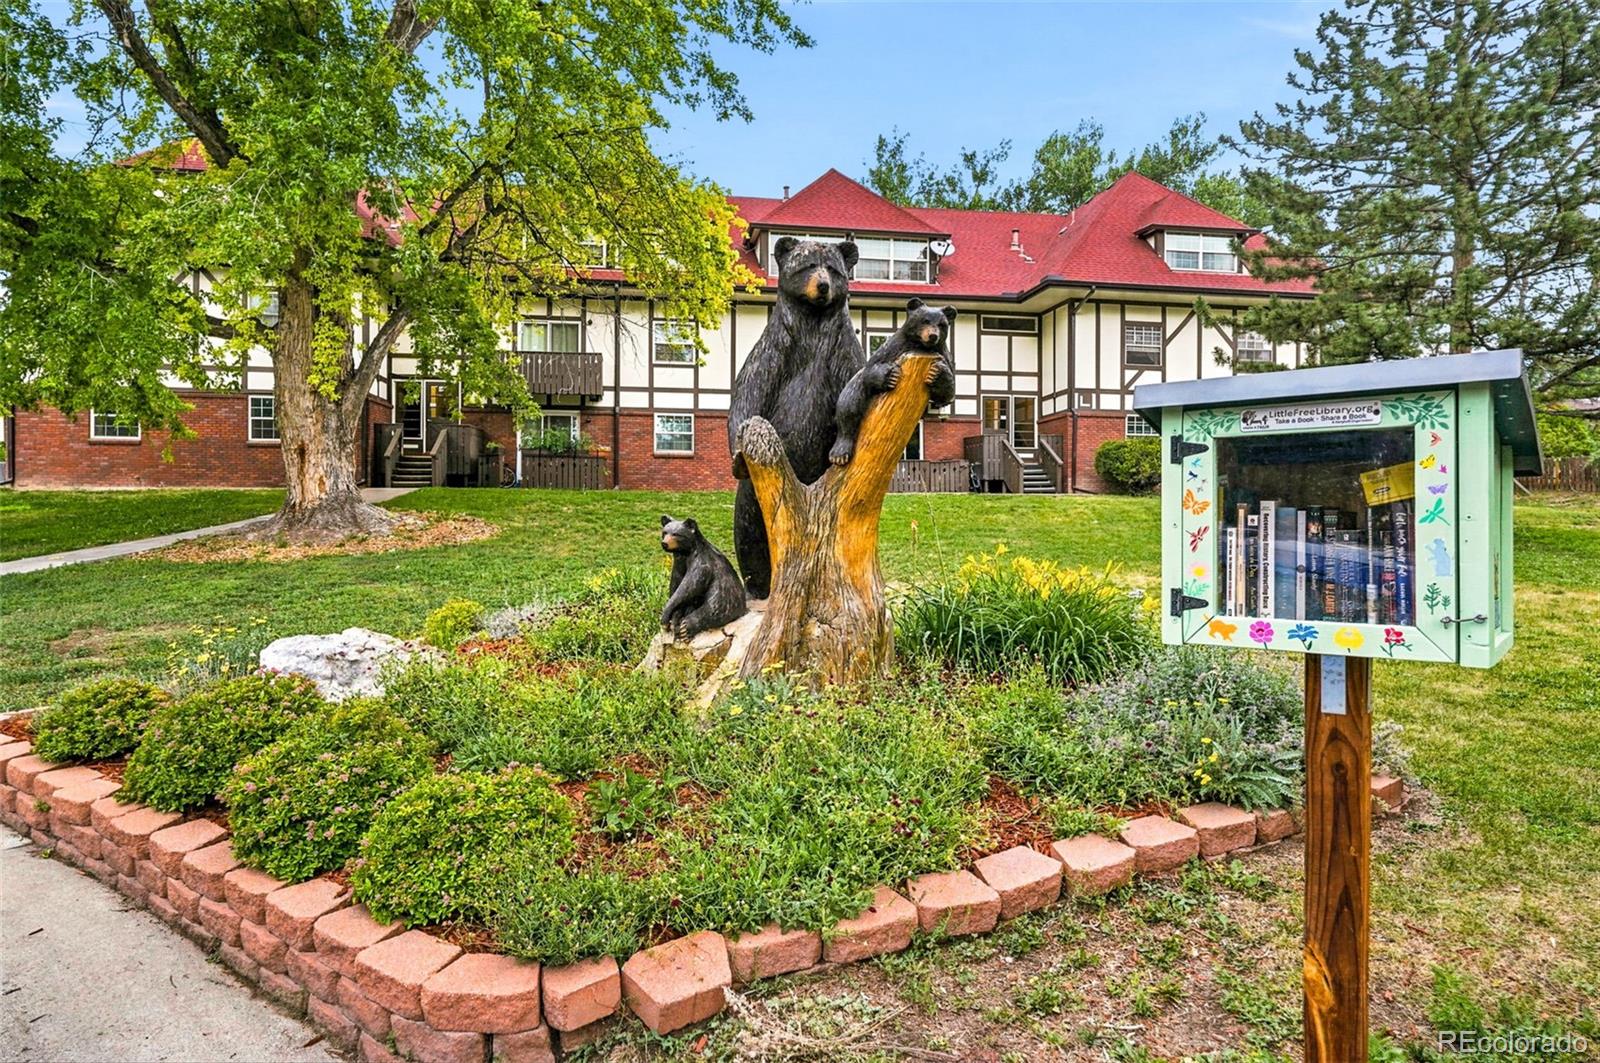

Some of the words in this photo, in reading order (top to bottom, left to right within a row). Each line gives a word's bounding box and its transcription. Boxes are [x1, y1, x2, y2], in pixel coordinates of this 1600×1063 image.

[1269, 405, 1373, 419] LittleFreeLibrary.org
[1262, 513, 1270, 541] Recovering
[1262, 562, 1270, 595] Constructing
[1262, 596, 1270, 609] Race
